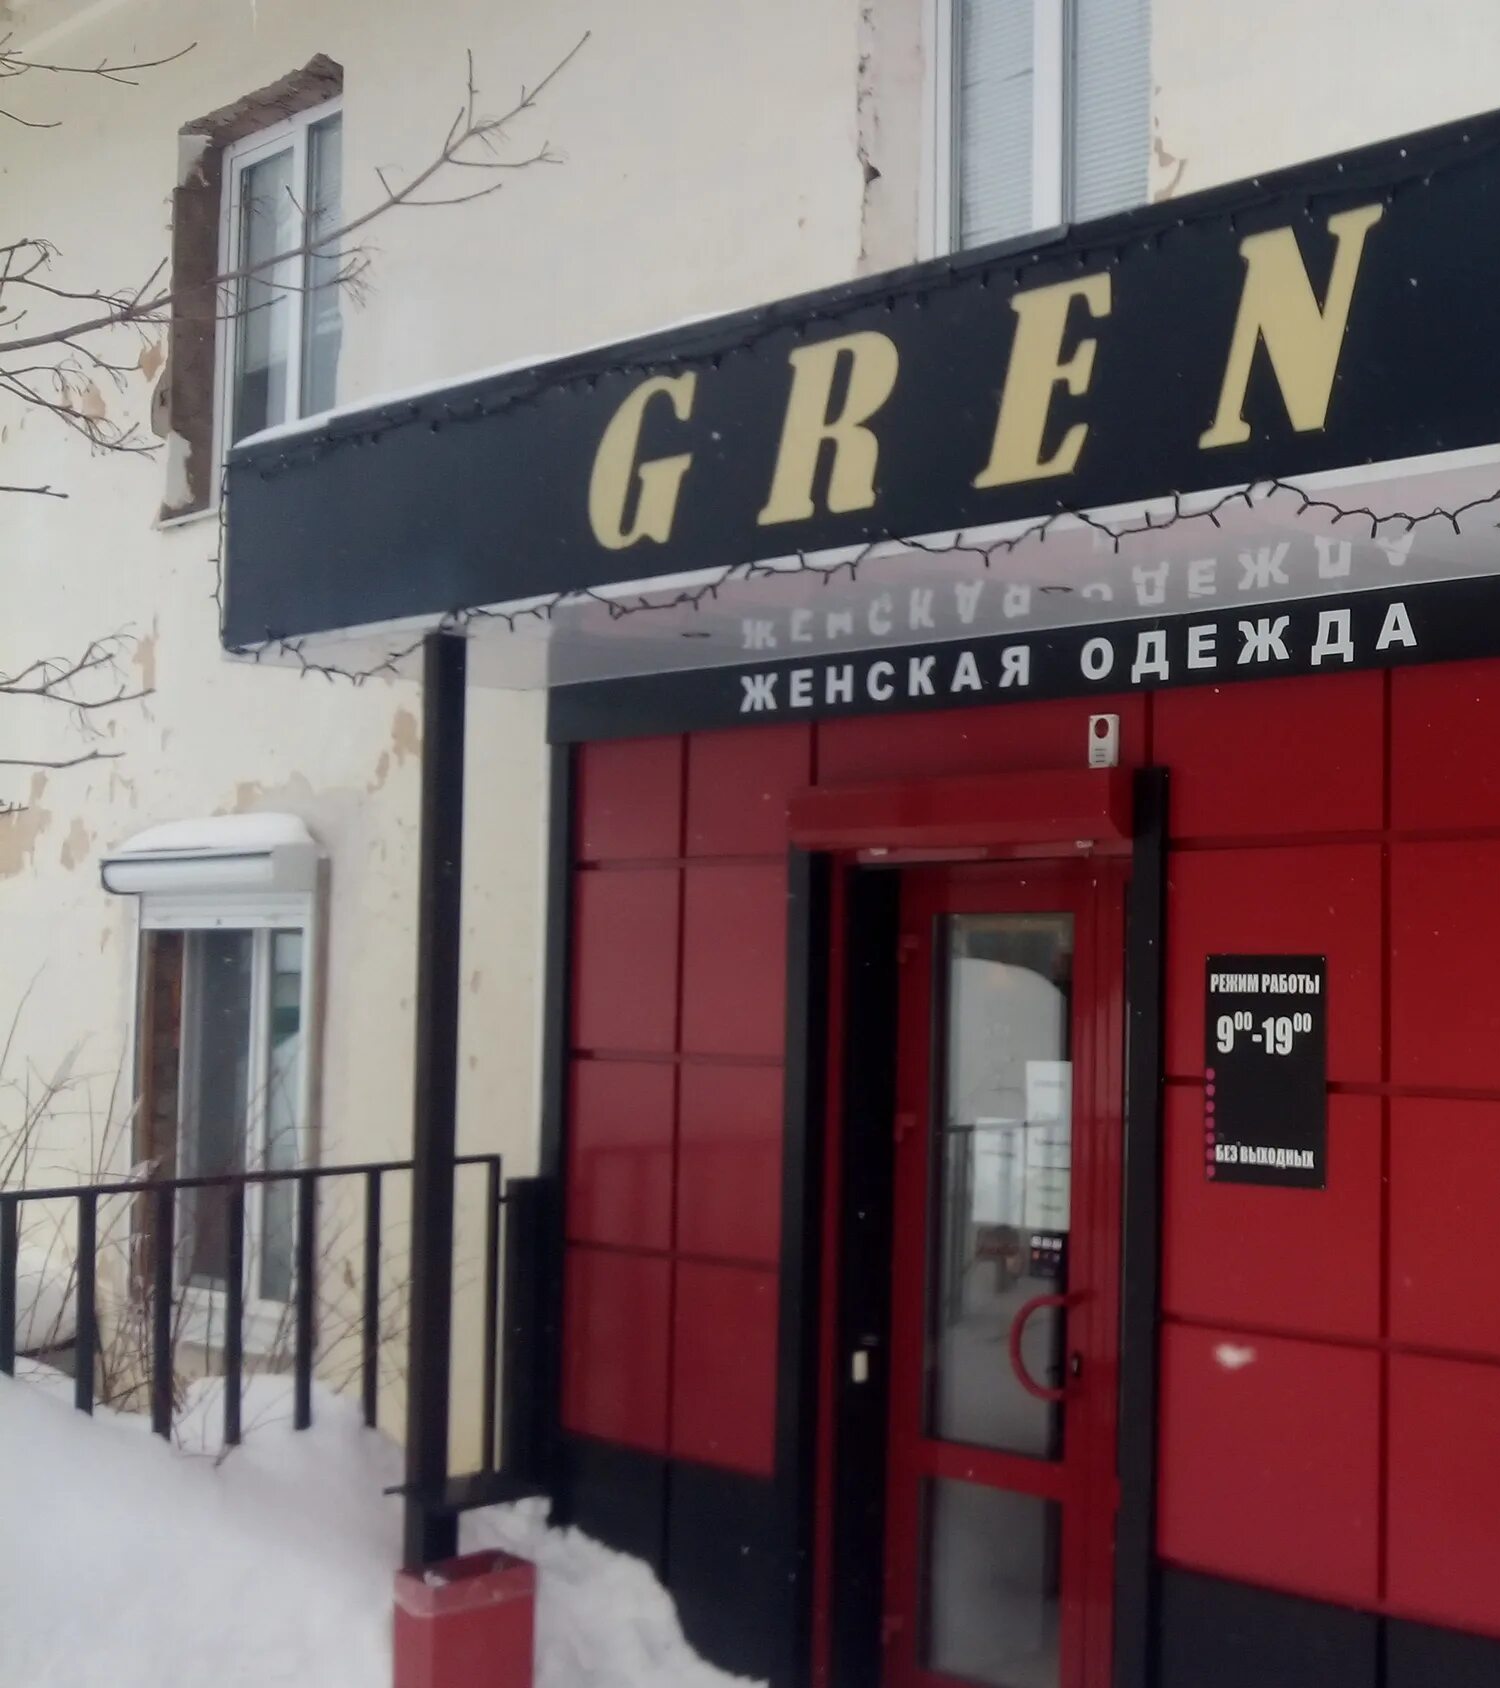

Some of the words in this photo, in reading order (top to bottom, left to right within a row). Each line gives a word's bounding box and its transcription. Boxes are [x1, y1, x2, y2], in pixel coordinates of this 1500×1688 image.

[587, 203, 1384, 551] GREN
[739, 645, 1031, 713] ЖЕНСКАЯ
[1080, 602, 1418, 684] ОДЕЖДА
[1210, 973, 1260, 994] РЕЖИМ
[1261, 974, 1320, 995] РАБОТЫ
[1215, 1144, 1238, 1164] БЕЗ
[1239, 1146, 1315, 1169] ВЫХОДНЫХ
